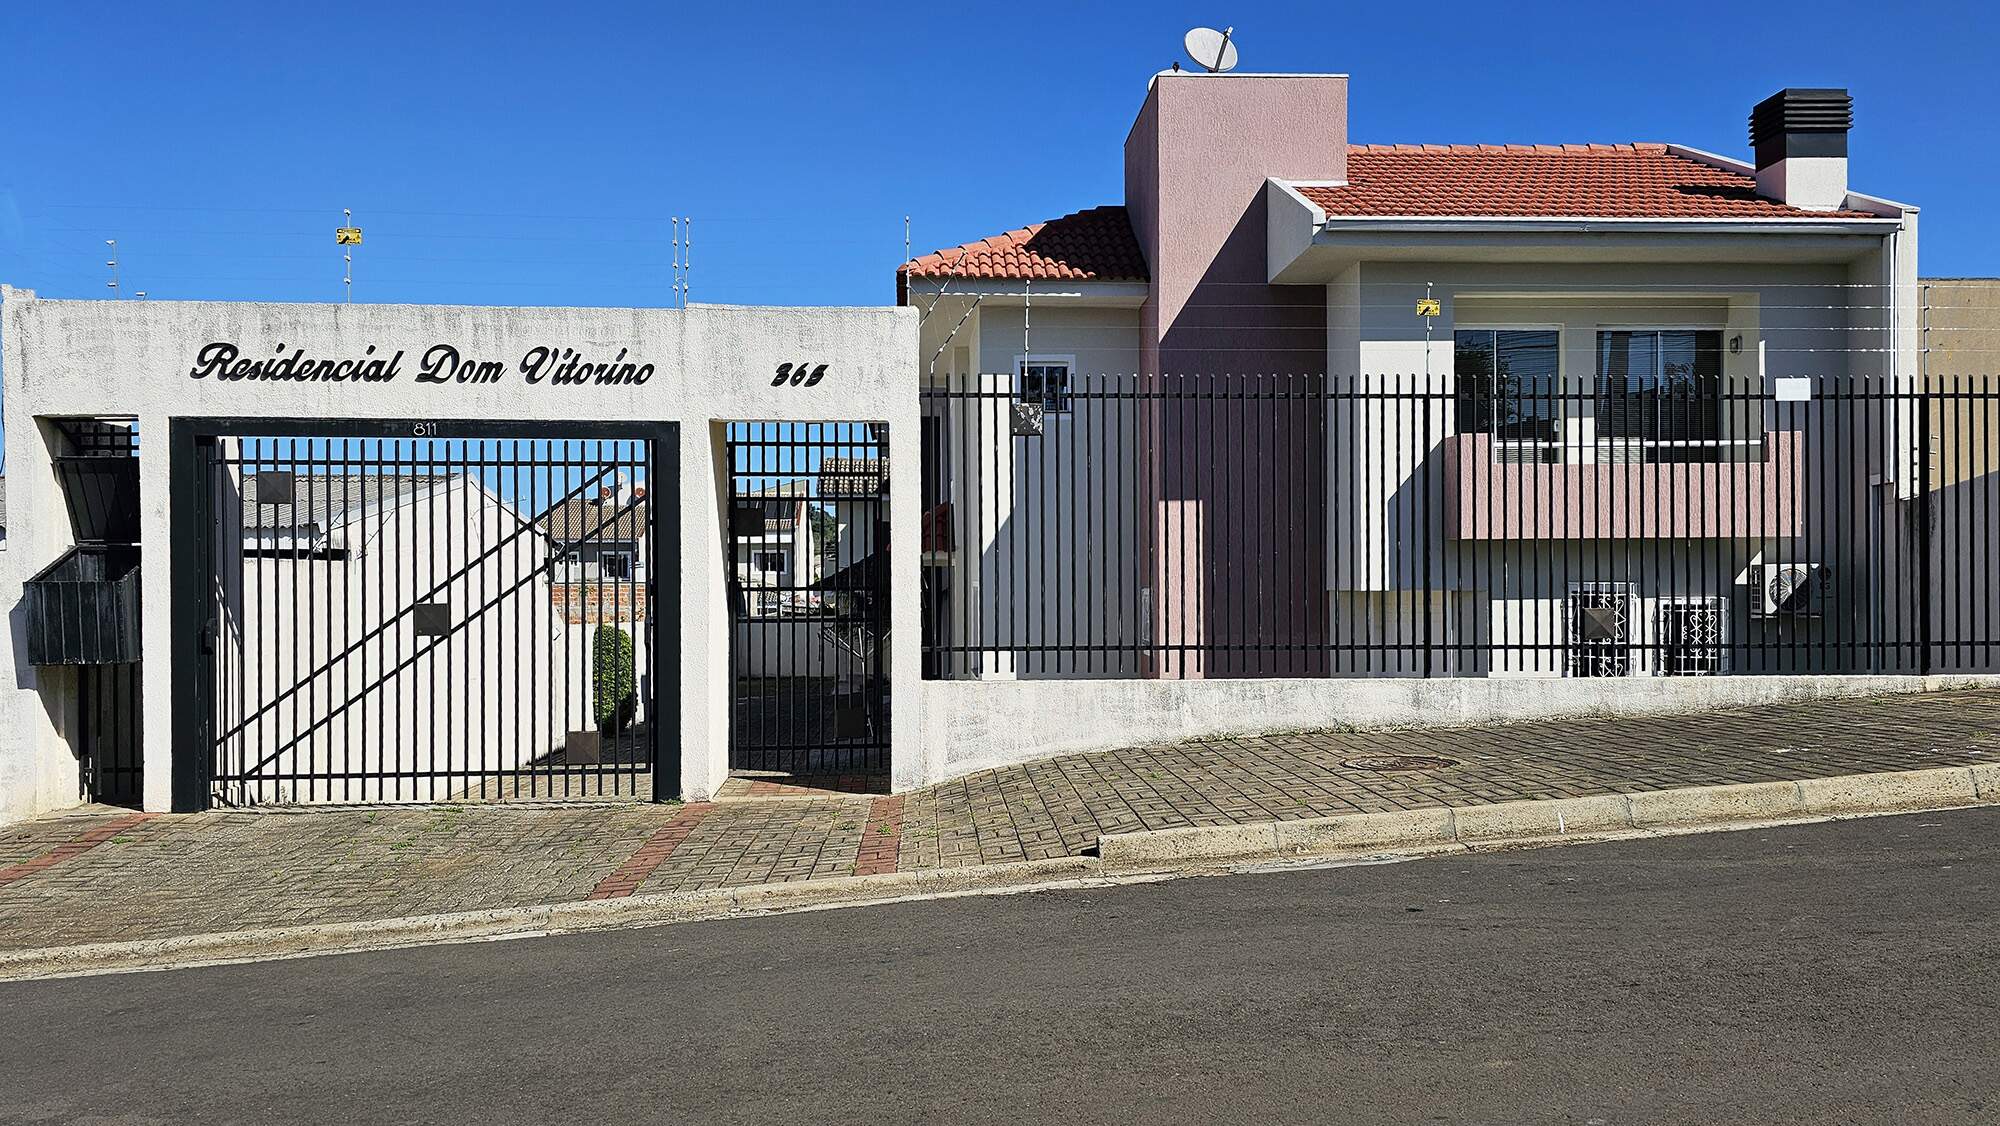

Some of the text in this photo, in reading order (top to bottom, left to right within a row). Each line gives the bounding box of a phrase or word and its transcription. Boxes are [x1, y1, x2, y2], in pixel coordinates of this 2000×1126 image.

[189, 342, 656, 386] Residencial Dom Vitorino
[413, 422, 437, 436] 811
